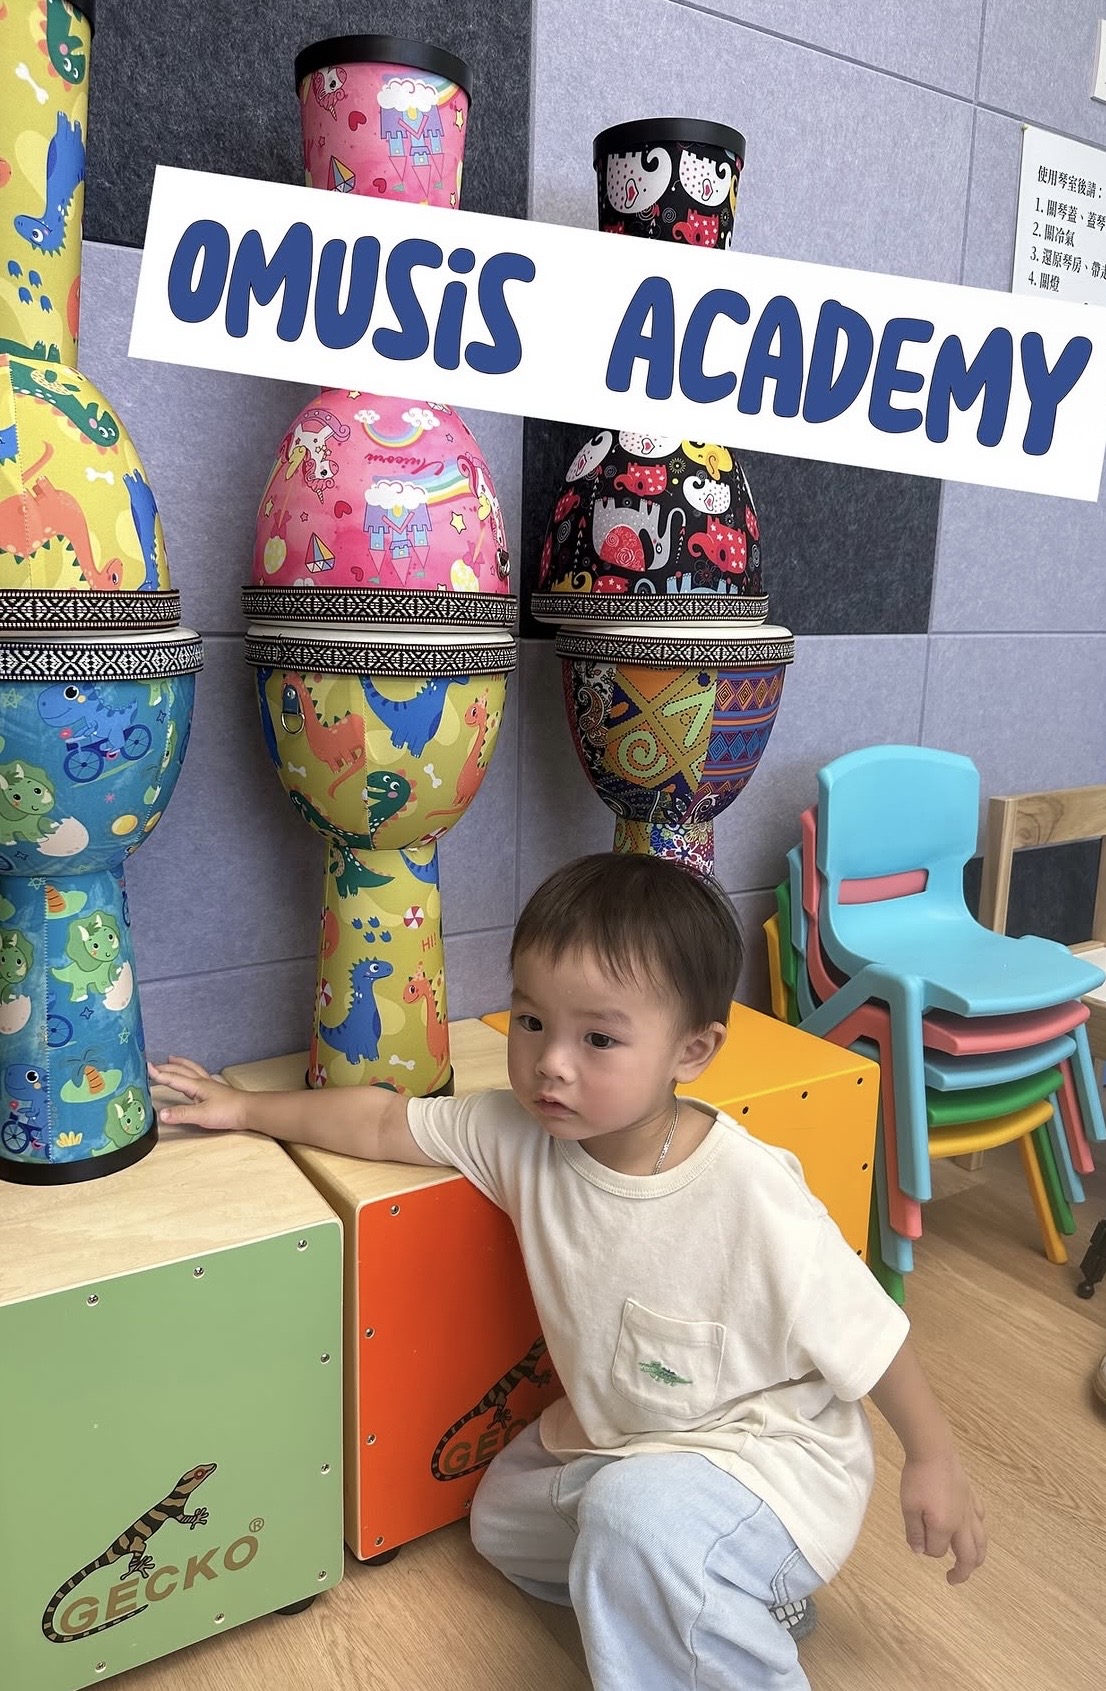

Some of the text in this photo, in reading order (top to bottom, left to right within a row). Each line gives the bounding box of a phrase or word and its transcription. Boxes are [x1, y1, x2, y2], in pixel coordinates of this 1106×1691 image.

[1035, 197, 1044, 213] 1.
[1032, 221, 1042, 238] 2.
[1030, 246, 1039, 262] 3.
[1028, 271, 1037, 286] 4.
[421, 932, 437, 953] HI!
[443, 1416, 536, 1474] GEC
[60, 1535, 259, 1635] GECKO
